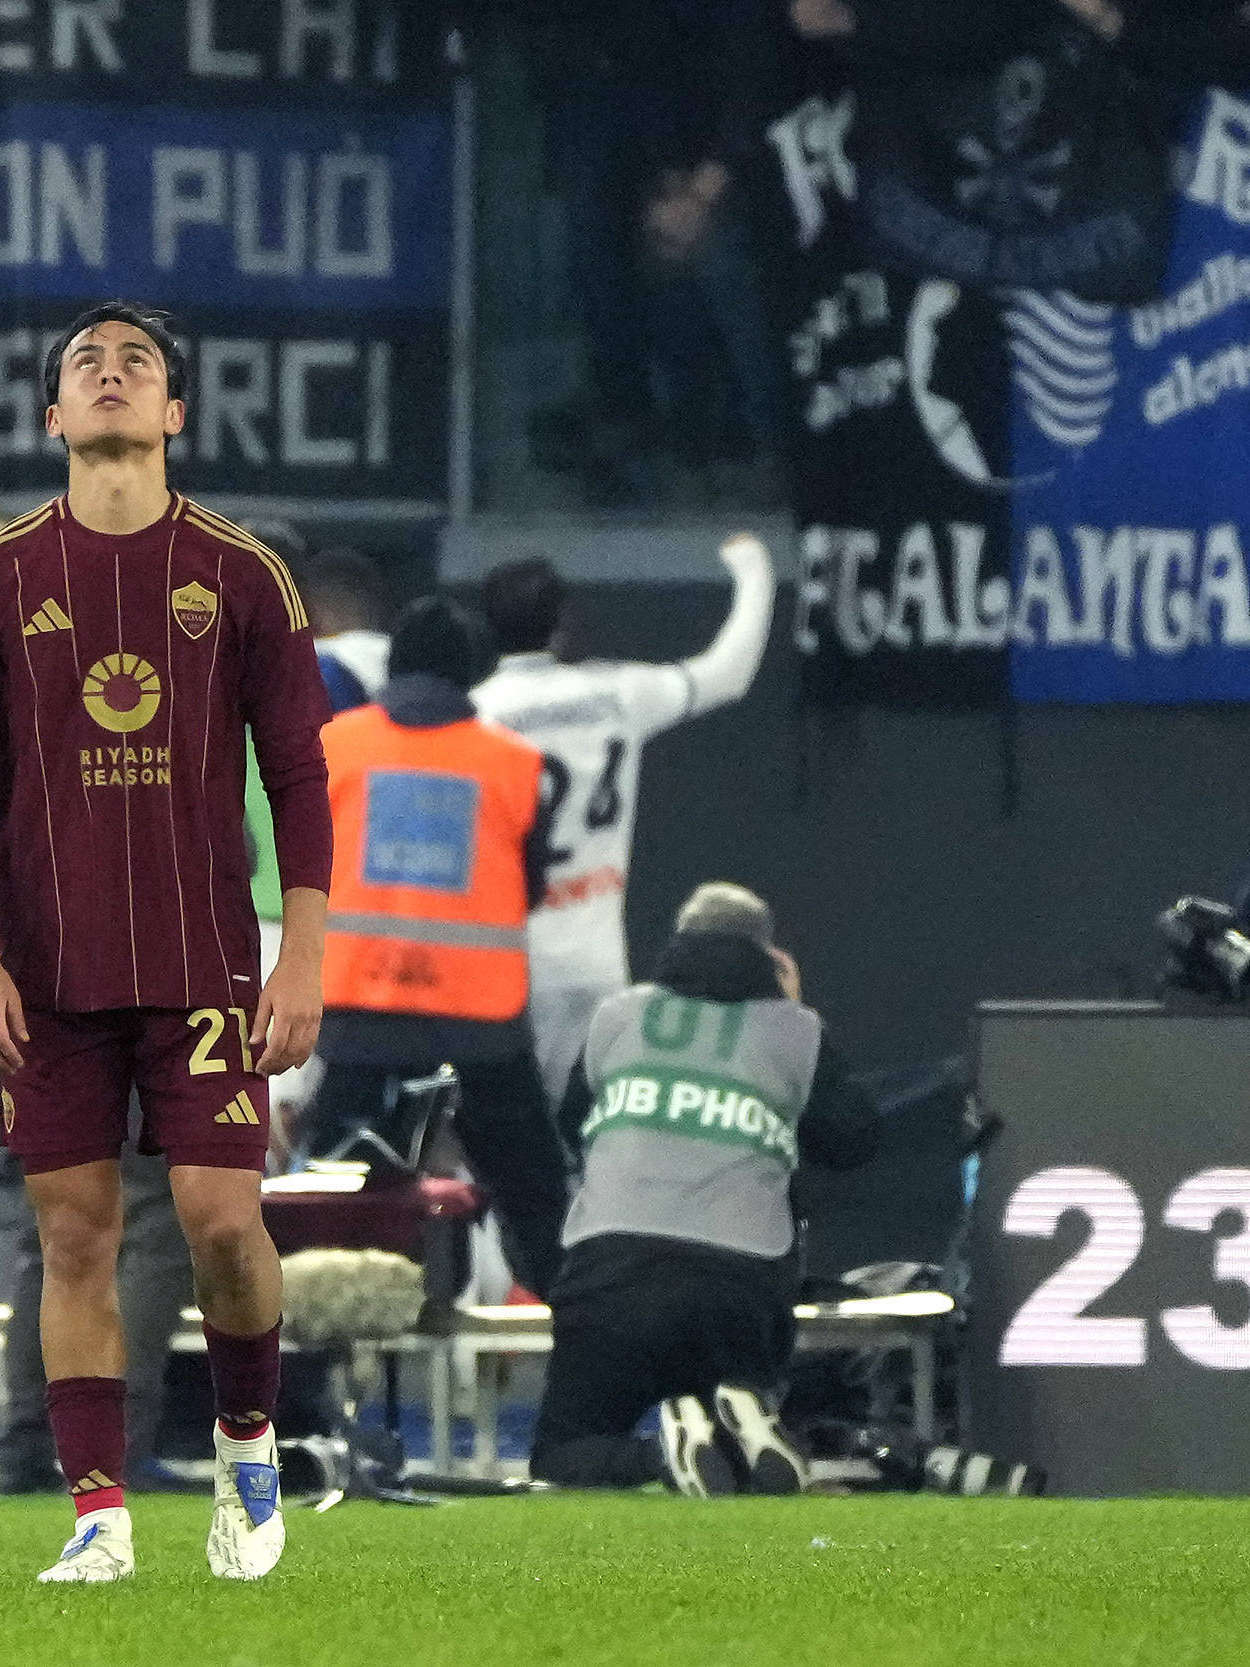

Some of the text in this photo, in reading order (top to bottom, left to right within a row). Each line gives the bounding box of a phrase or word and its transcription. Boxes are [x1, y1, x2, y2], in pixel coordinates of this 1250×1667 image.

[79, 746, 171, 766] RIYADH
[81, 767, 171, 787] SEASON
[186, 1007, 253, 1076] 21
[998, 1164, 1250, 1370] 23
